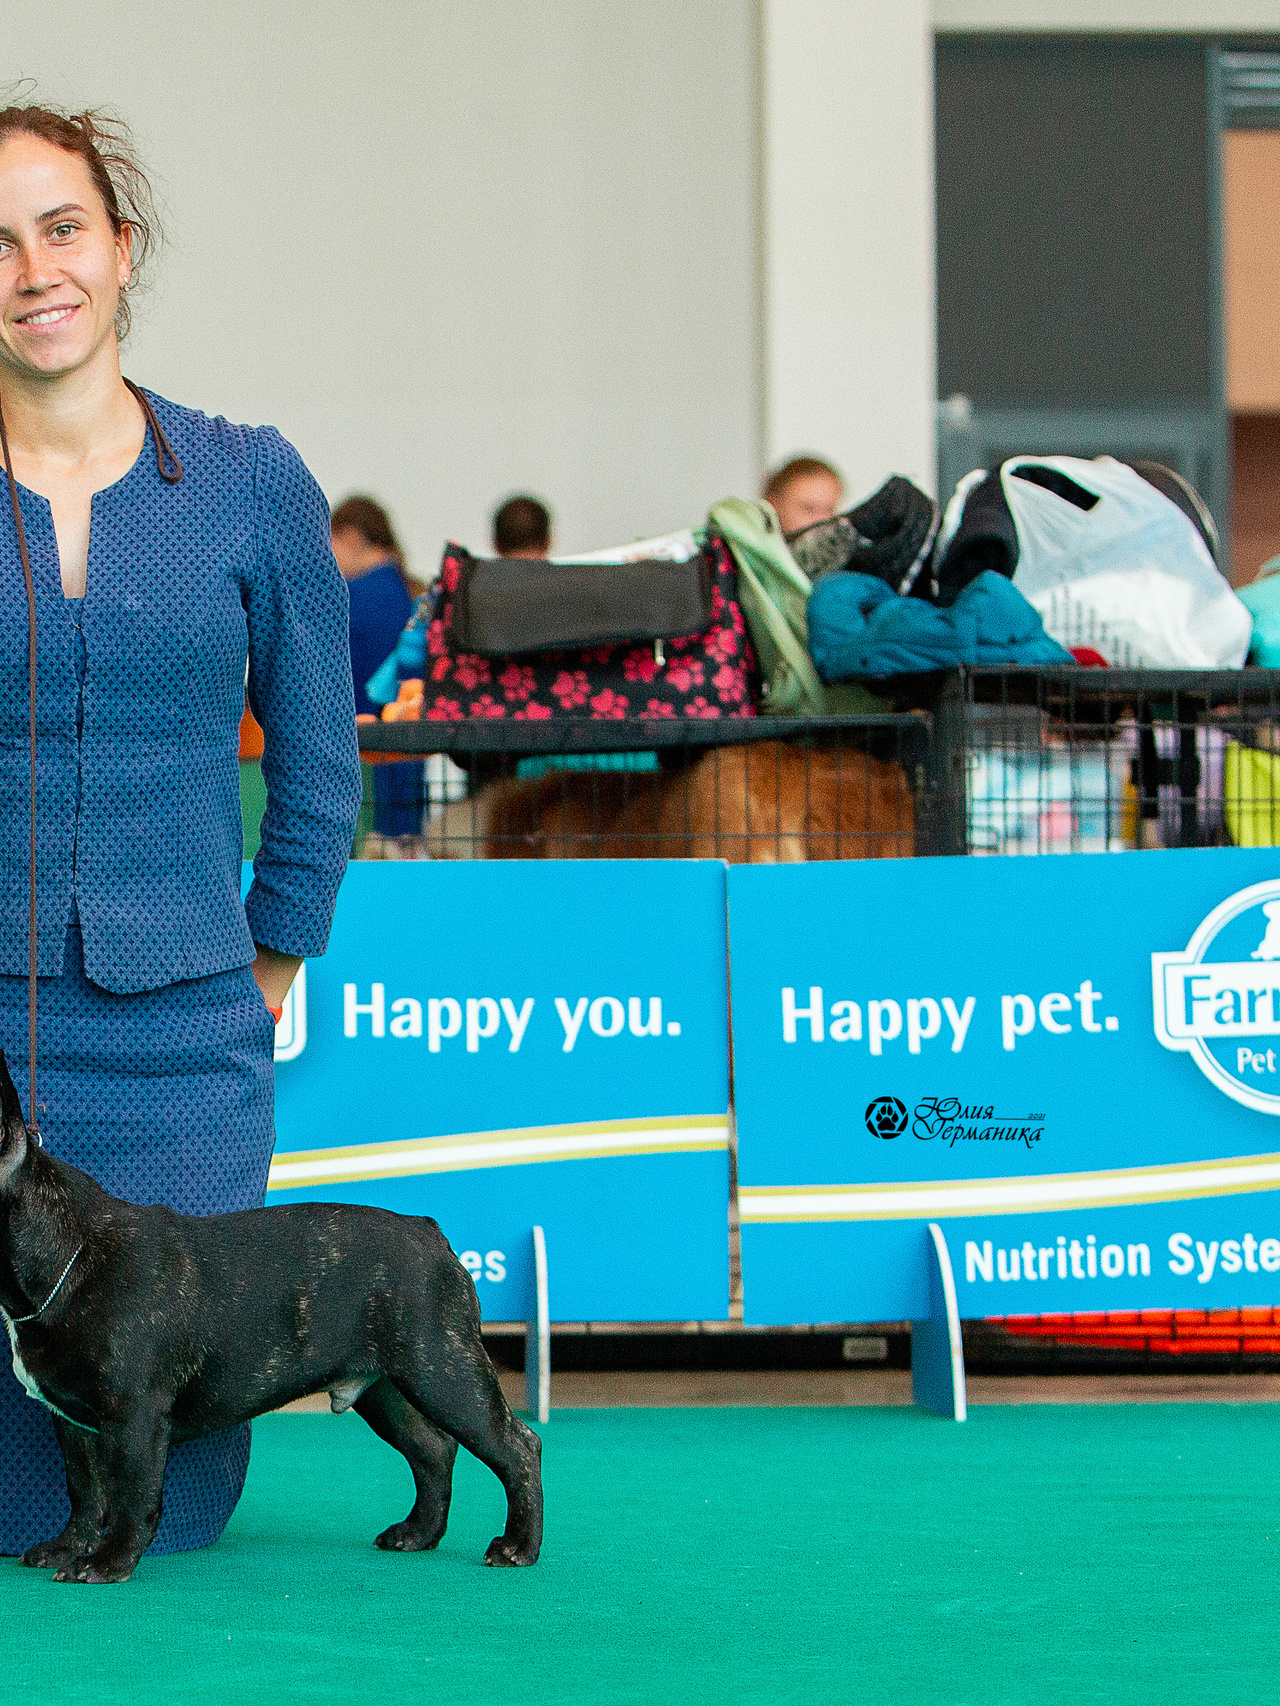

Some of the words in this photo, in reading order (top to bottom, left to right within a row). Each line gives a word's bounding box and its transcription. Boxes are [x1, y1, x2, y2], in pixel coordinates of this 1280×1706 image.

[343, 982, 535, 1053] Happy
[554, 996, 681, 1053] you.
[781, 986, 976, 1056] Happy
[1001, 979, 1119, 1051] pet.
[1236, 1047, 1277, 1074] Pet
[965, 1234, 1151, 1283] Nutrition
